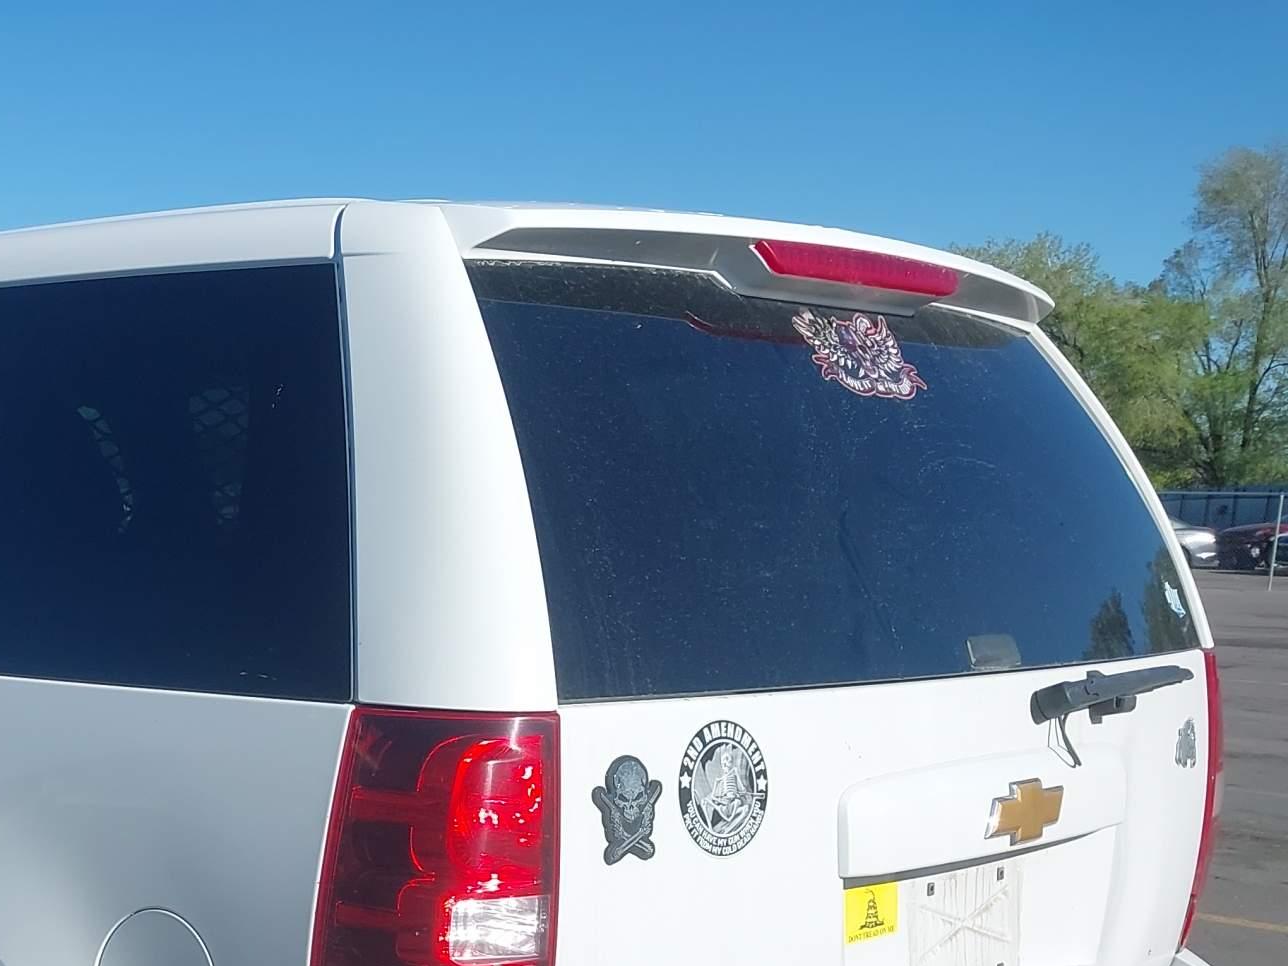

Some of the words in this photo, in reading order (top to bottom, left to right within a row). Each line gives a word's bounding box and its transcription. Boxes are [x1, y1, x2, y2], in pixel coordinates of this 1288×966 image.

[683, 736, 704, 770] 2ND
[702, 721, 765, 772] AMENDMENT
[686, 800, 696, 818] YOU
[692, 817, 704, 834] CAN
[702, 829, 717, 845] HAVE
[717, 838, 727, 846] MY
[691, 829, 699, 838] IT
[696, 836, 713, 852] FROM
[712, 846, 722, 855] MY
